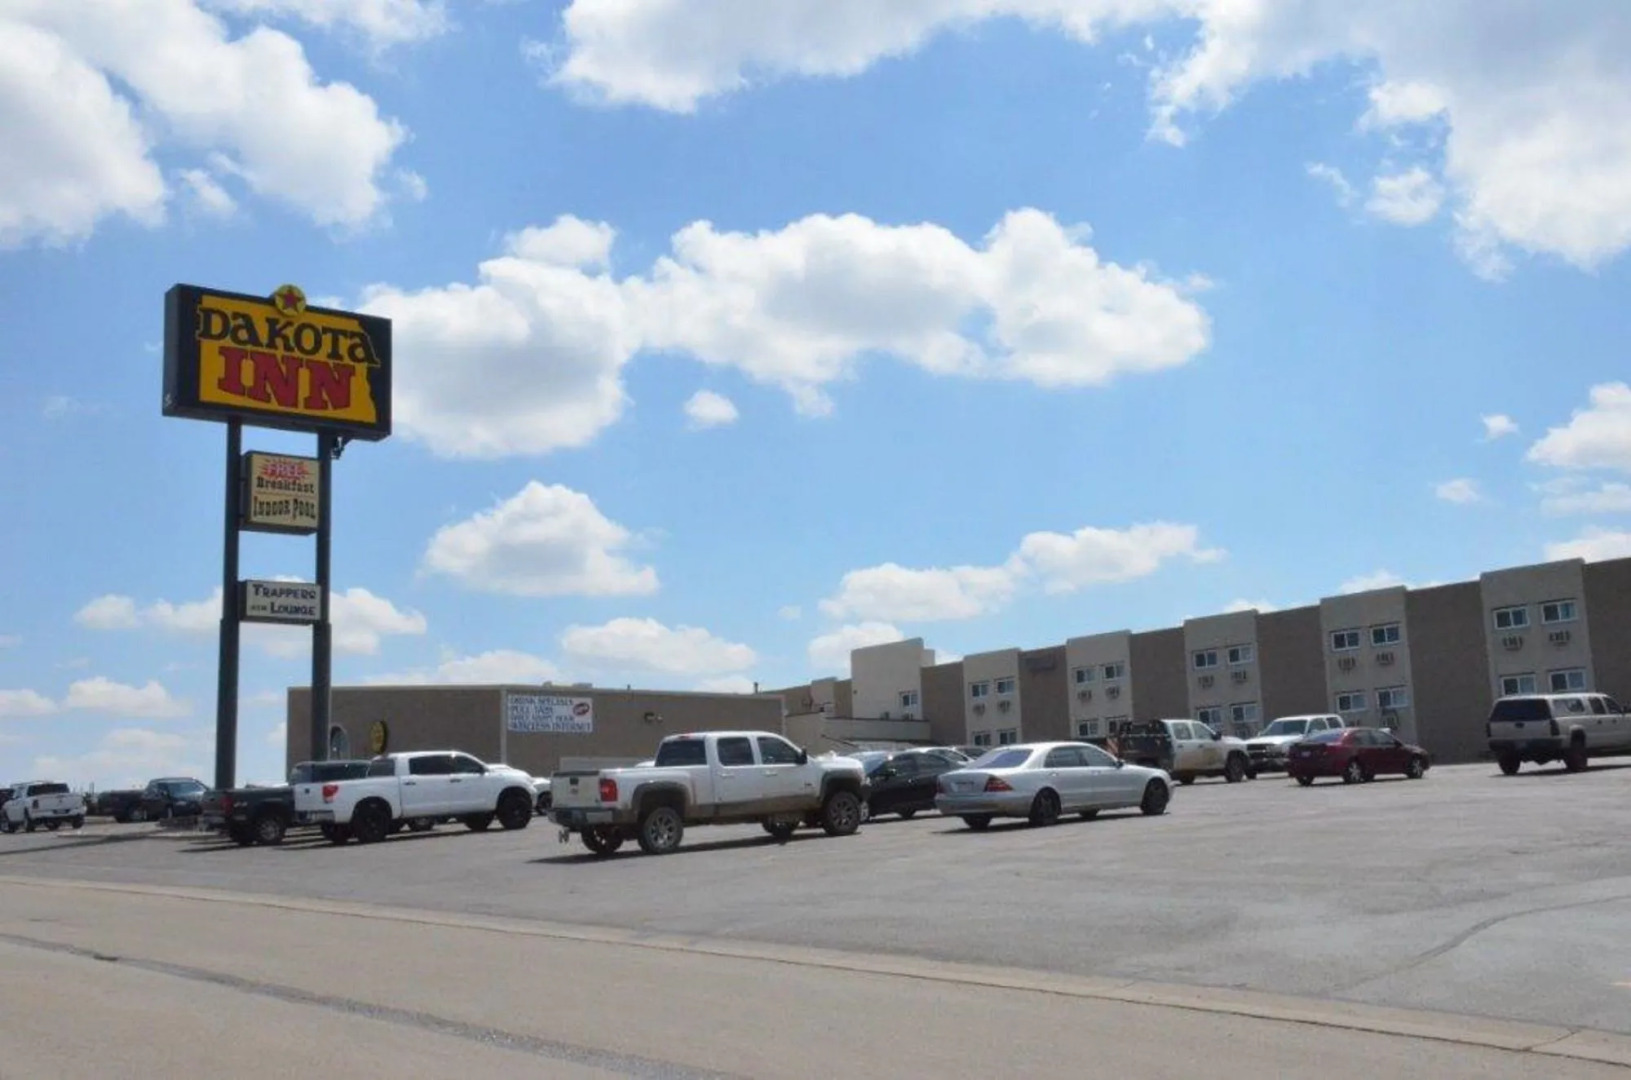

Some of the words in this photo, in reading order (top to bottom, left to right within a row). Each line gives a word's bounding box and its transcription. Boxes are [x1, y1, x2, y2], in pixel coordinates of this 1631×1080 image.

[217, 345, 356, 411] INN
[256, 476, 315, 494] Breakfast
[252, 583, 317, 600] TRAPPERS
[270, 602, 316, 616] LOUNGE
